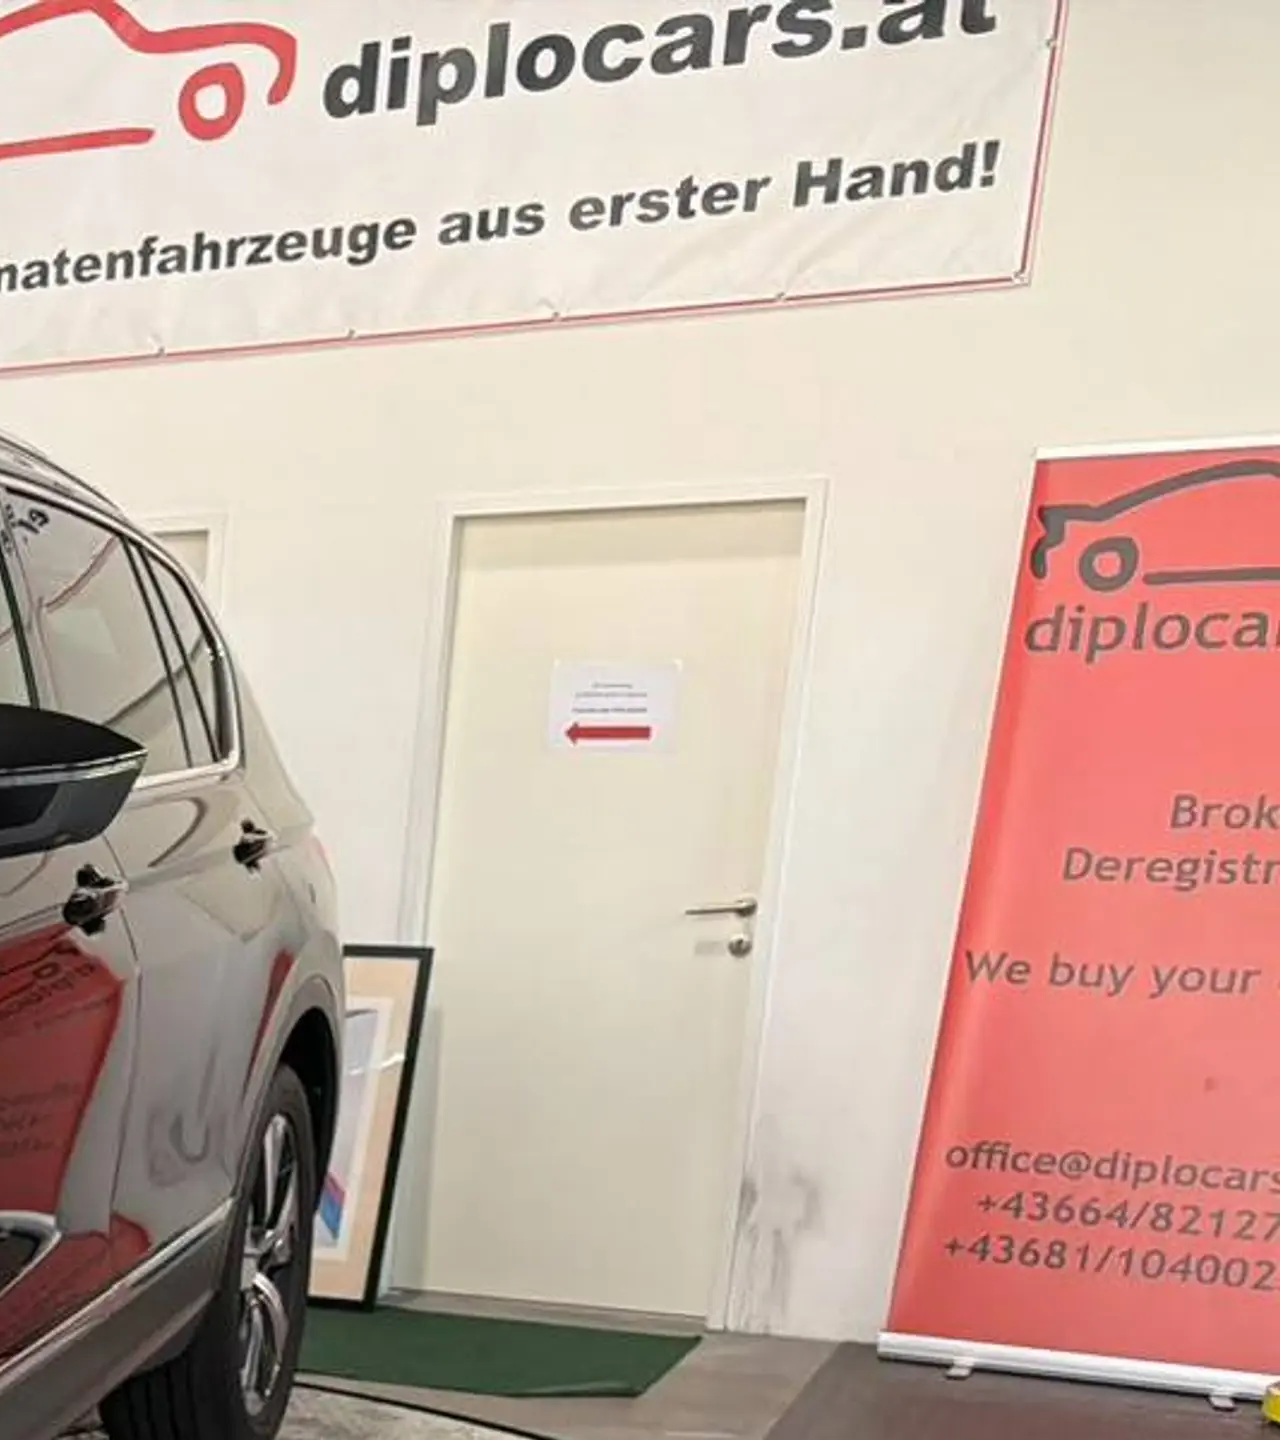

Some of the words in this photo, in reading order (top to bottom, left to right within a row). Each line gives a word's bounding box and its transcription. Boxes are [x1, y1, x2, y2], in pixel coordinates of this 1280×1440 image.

[438, 201, 546, 245] aus
[569, 175, 772, 231] erster
[793, 140, 1001, 207] Hand!
[1024, 601, 1280, 664] diploca
[1062, 848, 1280, 892] Deregistr
[965, 950, 1031, 985] We
[1048, 952, 1134, 997] buy
[1148, 964, 1262, 1000] your
